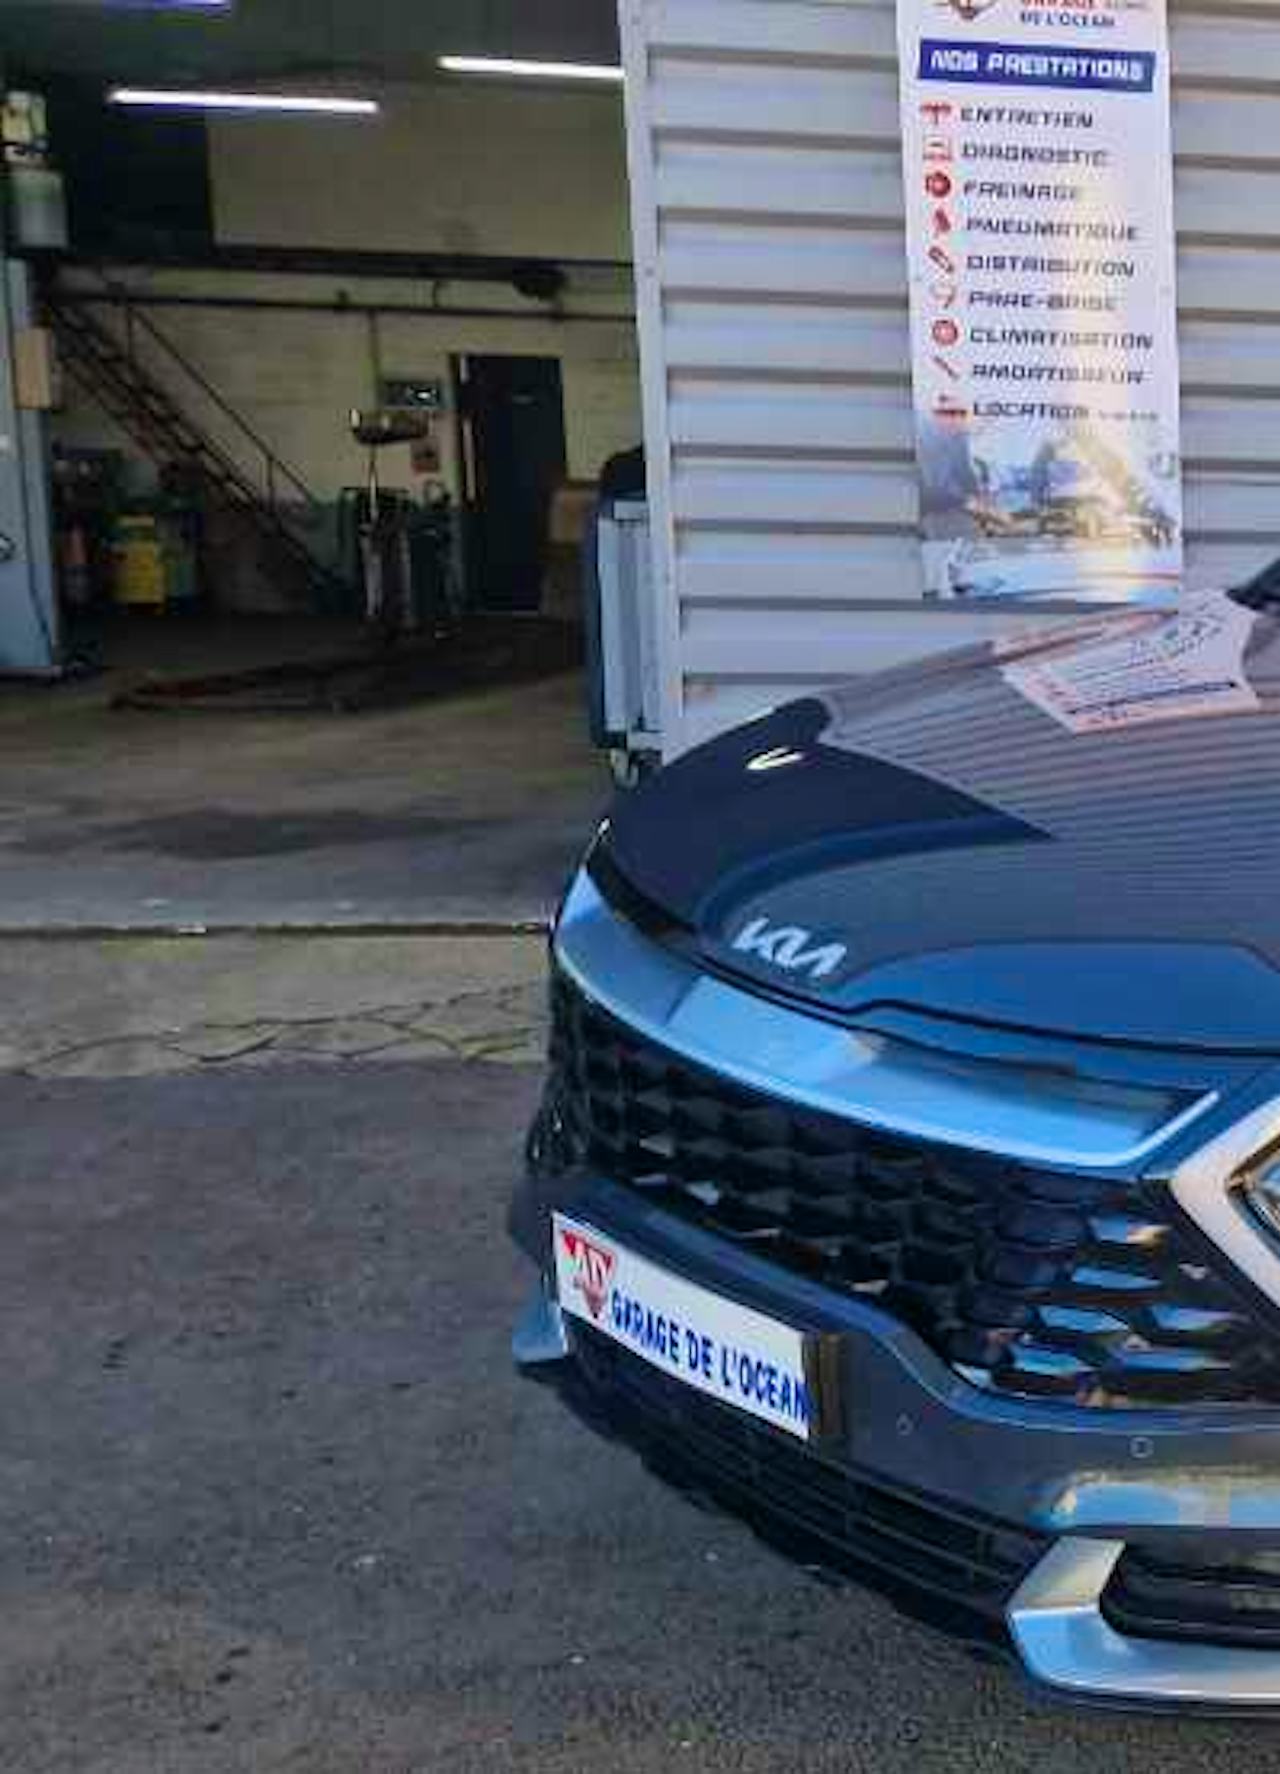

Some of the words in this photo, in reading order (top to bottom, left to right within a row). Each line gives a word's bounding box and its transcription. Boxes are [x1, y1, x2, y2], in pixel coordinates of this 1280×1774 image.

[930, 50, 978, 72] NOS
[987, 53, 1144, 81] PRESTATIONS
[960, 107, 1093, 128] ENTRETIEN
[962, 142, 1107, 167] DIAGNOSTIC
[963, 180, 1079, 201] FREINAGE
[966, 217, 1139, 241] PNEUMATIQUE
[966, 254, 1134, 277] DISTRIBUTION
[968, 290, 1118, 311] PARE-BRISE
[969, 329, 1154, 350] CLIMATISATION
[972, 364, 1149, 385] AMORTISSEUR
[973, 402, 1089, 420] LOCATION
[731, 917, 848, 978] KIA
[611, 1288, 679, 1362] GARAGE
[685, 1328, 712, 1378] DE
[721, 1344, 811, 1423] L'OCEAN
